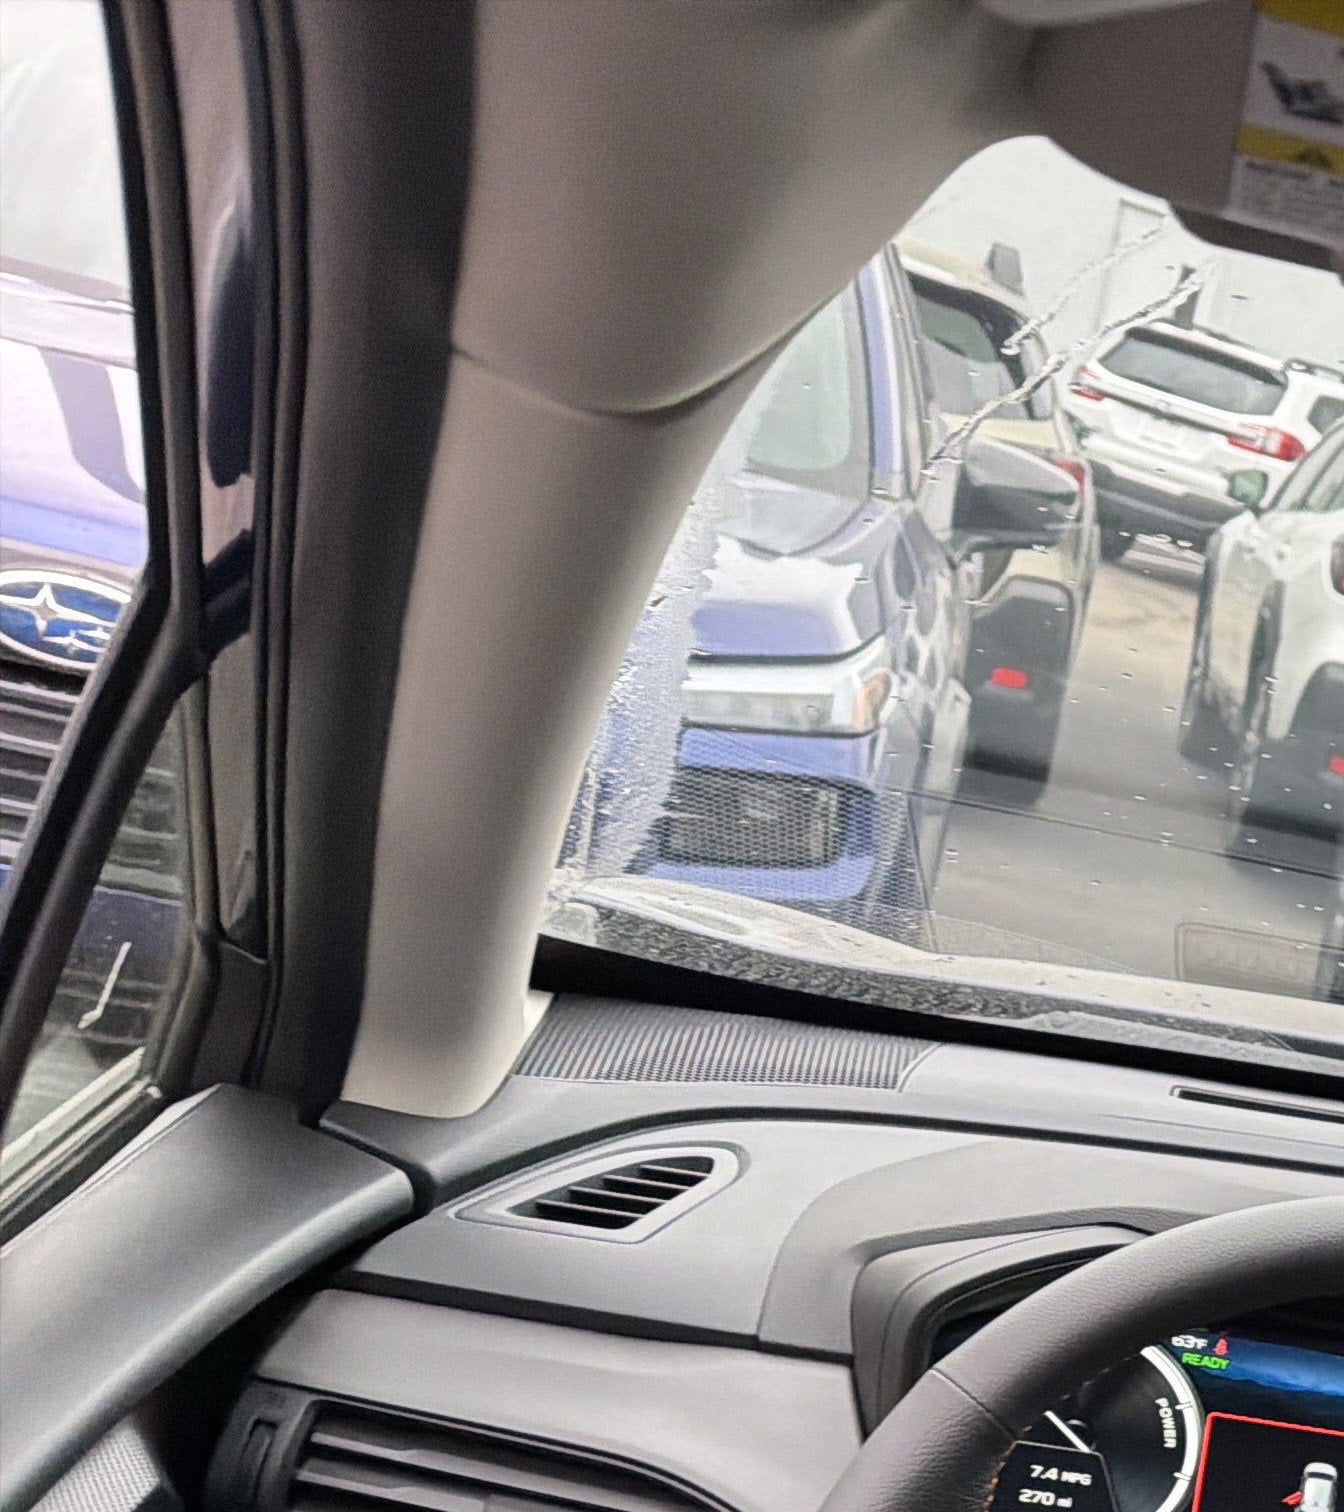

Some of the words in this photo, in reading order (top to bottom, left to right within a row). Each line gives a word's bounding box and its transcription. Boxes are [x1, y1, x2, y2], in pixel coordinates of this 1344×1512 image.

[1181, 1352, 1230, 1371] READY
[1155, 1397, 1178, 1449] POWER
[1030, 1464, 1058, 1481] 7.4
[1061, 1469, 1092, 1486] MPG
[1018, 1488, 1054, 1506] 270
